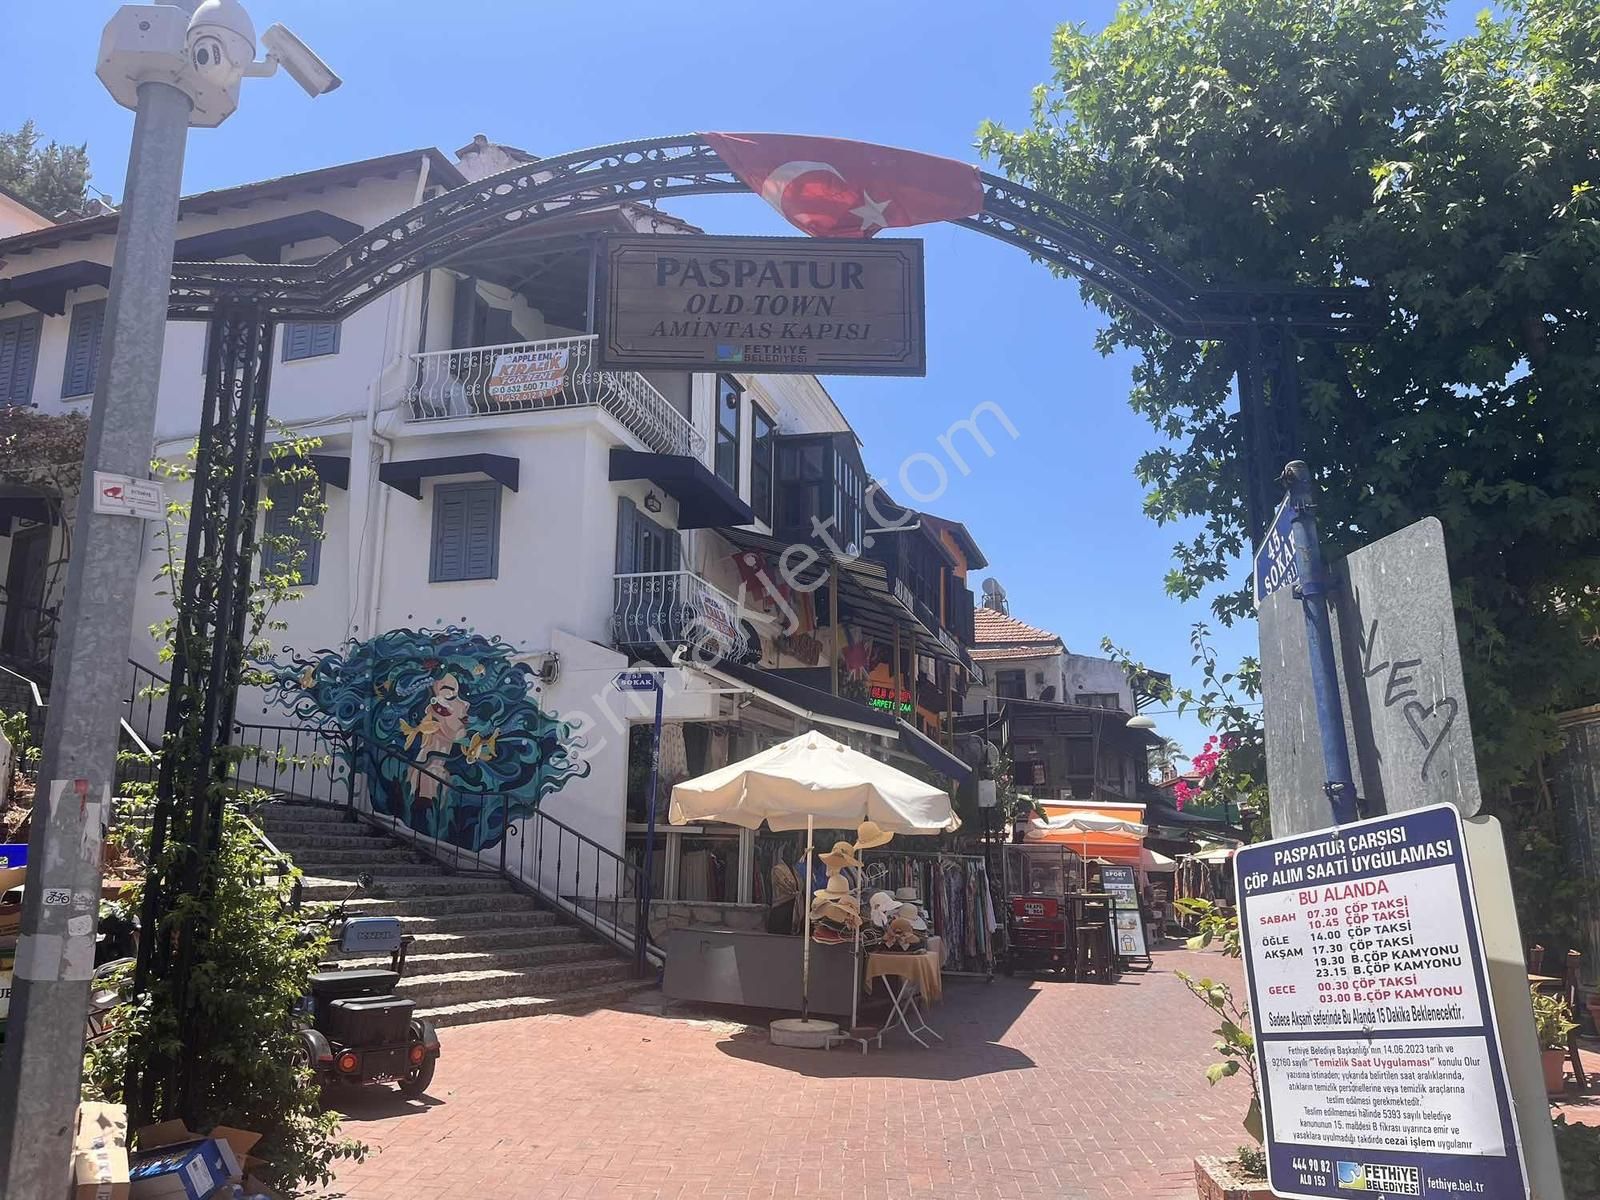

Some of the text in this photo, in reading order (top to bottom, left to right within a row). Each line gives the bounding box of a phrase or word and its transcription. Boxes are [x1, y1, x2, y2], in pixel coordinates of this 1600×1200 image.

[656, 257, 865, 290] PASPATUR
[686, 294, 835, 317] OLD TOWN
[650, 317, 872, 340] AMİNTAS KAPISI
[1274, 826, 1407, 866] PASPATUR ÇARŞISI
[1244, 839, 1453, 895] ÇÖP ALIM SAATİ UYGULAMASI
[1299, 880, 1389, 906] BU ALANDA
[1259, 895, 1409, 925] SABAH 07.30 ÇÖP TAKSİ
[1309, 909, 1410, 930] 10.45 ÇÖP TAKSİ
[1262, 919, 1412, 947] ÖĞLE 14.00 ÇÖP TAKSİ
[1264, 934, 1414, 960] AKŞAM 17.30 ÇÖP TAKSİ
[1314, 944, 1460, 967] 19.30 B.ÇÖP KAMYONU
[1316, 957, 1462, 978] 23.15 B.ÇÖP KAMYONU
[1268, 973, 1418, 995] GECE 00.30 ÇÖP TAKSİ
[1319, 985, 1463, 1004] 03.00 B.ÇÖP KAMYONU
[1268, 1003, 1465, 1029] Sadece Akşam seferinde Bu Alanda 15 Dakika Beklenecektir.
[1288, 1046, 1309, 1055] Fethiye
[1310, 1046, 1336, 1055] Belediye
[1383, 1044, 1424, 1054] 14.06.2023
[1426, 1044, 1443, 1053] tarih
[1446, 1045, 1454, 1053] ve
[1292, 1058, 1308, 1068] sayılı
[1351, 1058, 1371, 1067] Saat
[1438, 1057, 1463, 1066] konulu
[1464, 1056, 1480, 1066] Olur
[1342, 1070, 1368, 1080] yukarıda
[1370, 1070, 1399, 1080] belirtilen
[1400, 1072, 1418, 1080] saat
[1418, 1070, 1465, 1080] aralıklarında,
[1289, 1083, 1465, 1095] atıkların temizlik personellerine veya temizlik araçlarına
[1326, 1096, 1421, 1107] teslim edilmesi gerekmektedir.
[1304, 1106, 1322, 1115] Teslim
[1324, 1107, 1357, 1117] edilmemesi
[1383, 1110, 1401, 1119] 5393
[1403, 1111, 1421, 1121] sayılı
[1422, 1111, 1452, 1122] belediye
[1300, 1120, 1332, 1129] kanununun
[1334, 1120, 1345, 1129] 15.
[1346, 1121, 1371, 1131] maddesi
[1372, 1122, 1378, 1131] B
[1402, 1125, 1431, 1134] uyarınca
[1433, 1125, 1449, 1134] emir
[1450, 1127, 1460, 1135] ve
[1293, 1131, 1472, 1150] yasaklara uyulmadığı takdirde cezai işlem uygulanır
[1292, 1157, 1331, 1173] 444 90 82
[1300, 1174, 1326, 1187] ALO 153
[1427, 1176, 1485, 1193] fethiye.bel.tr
